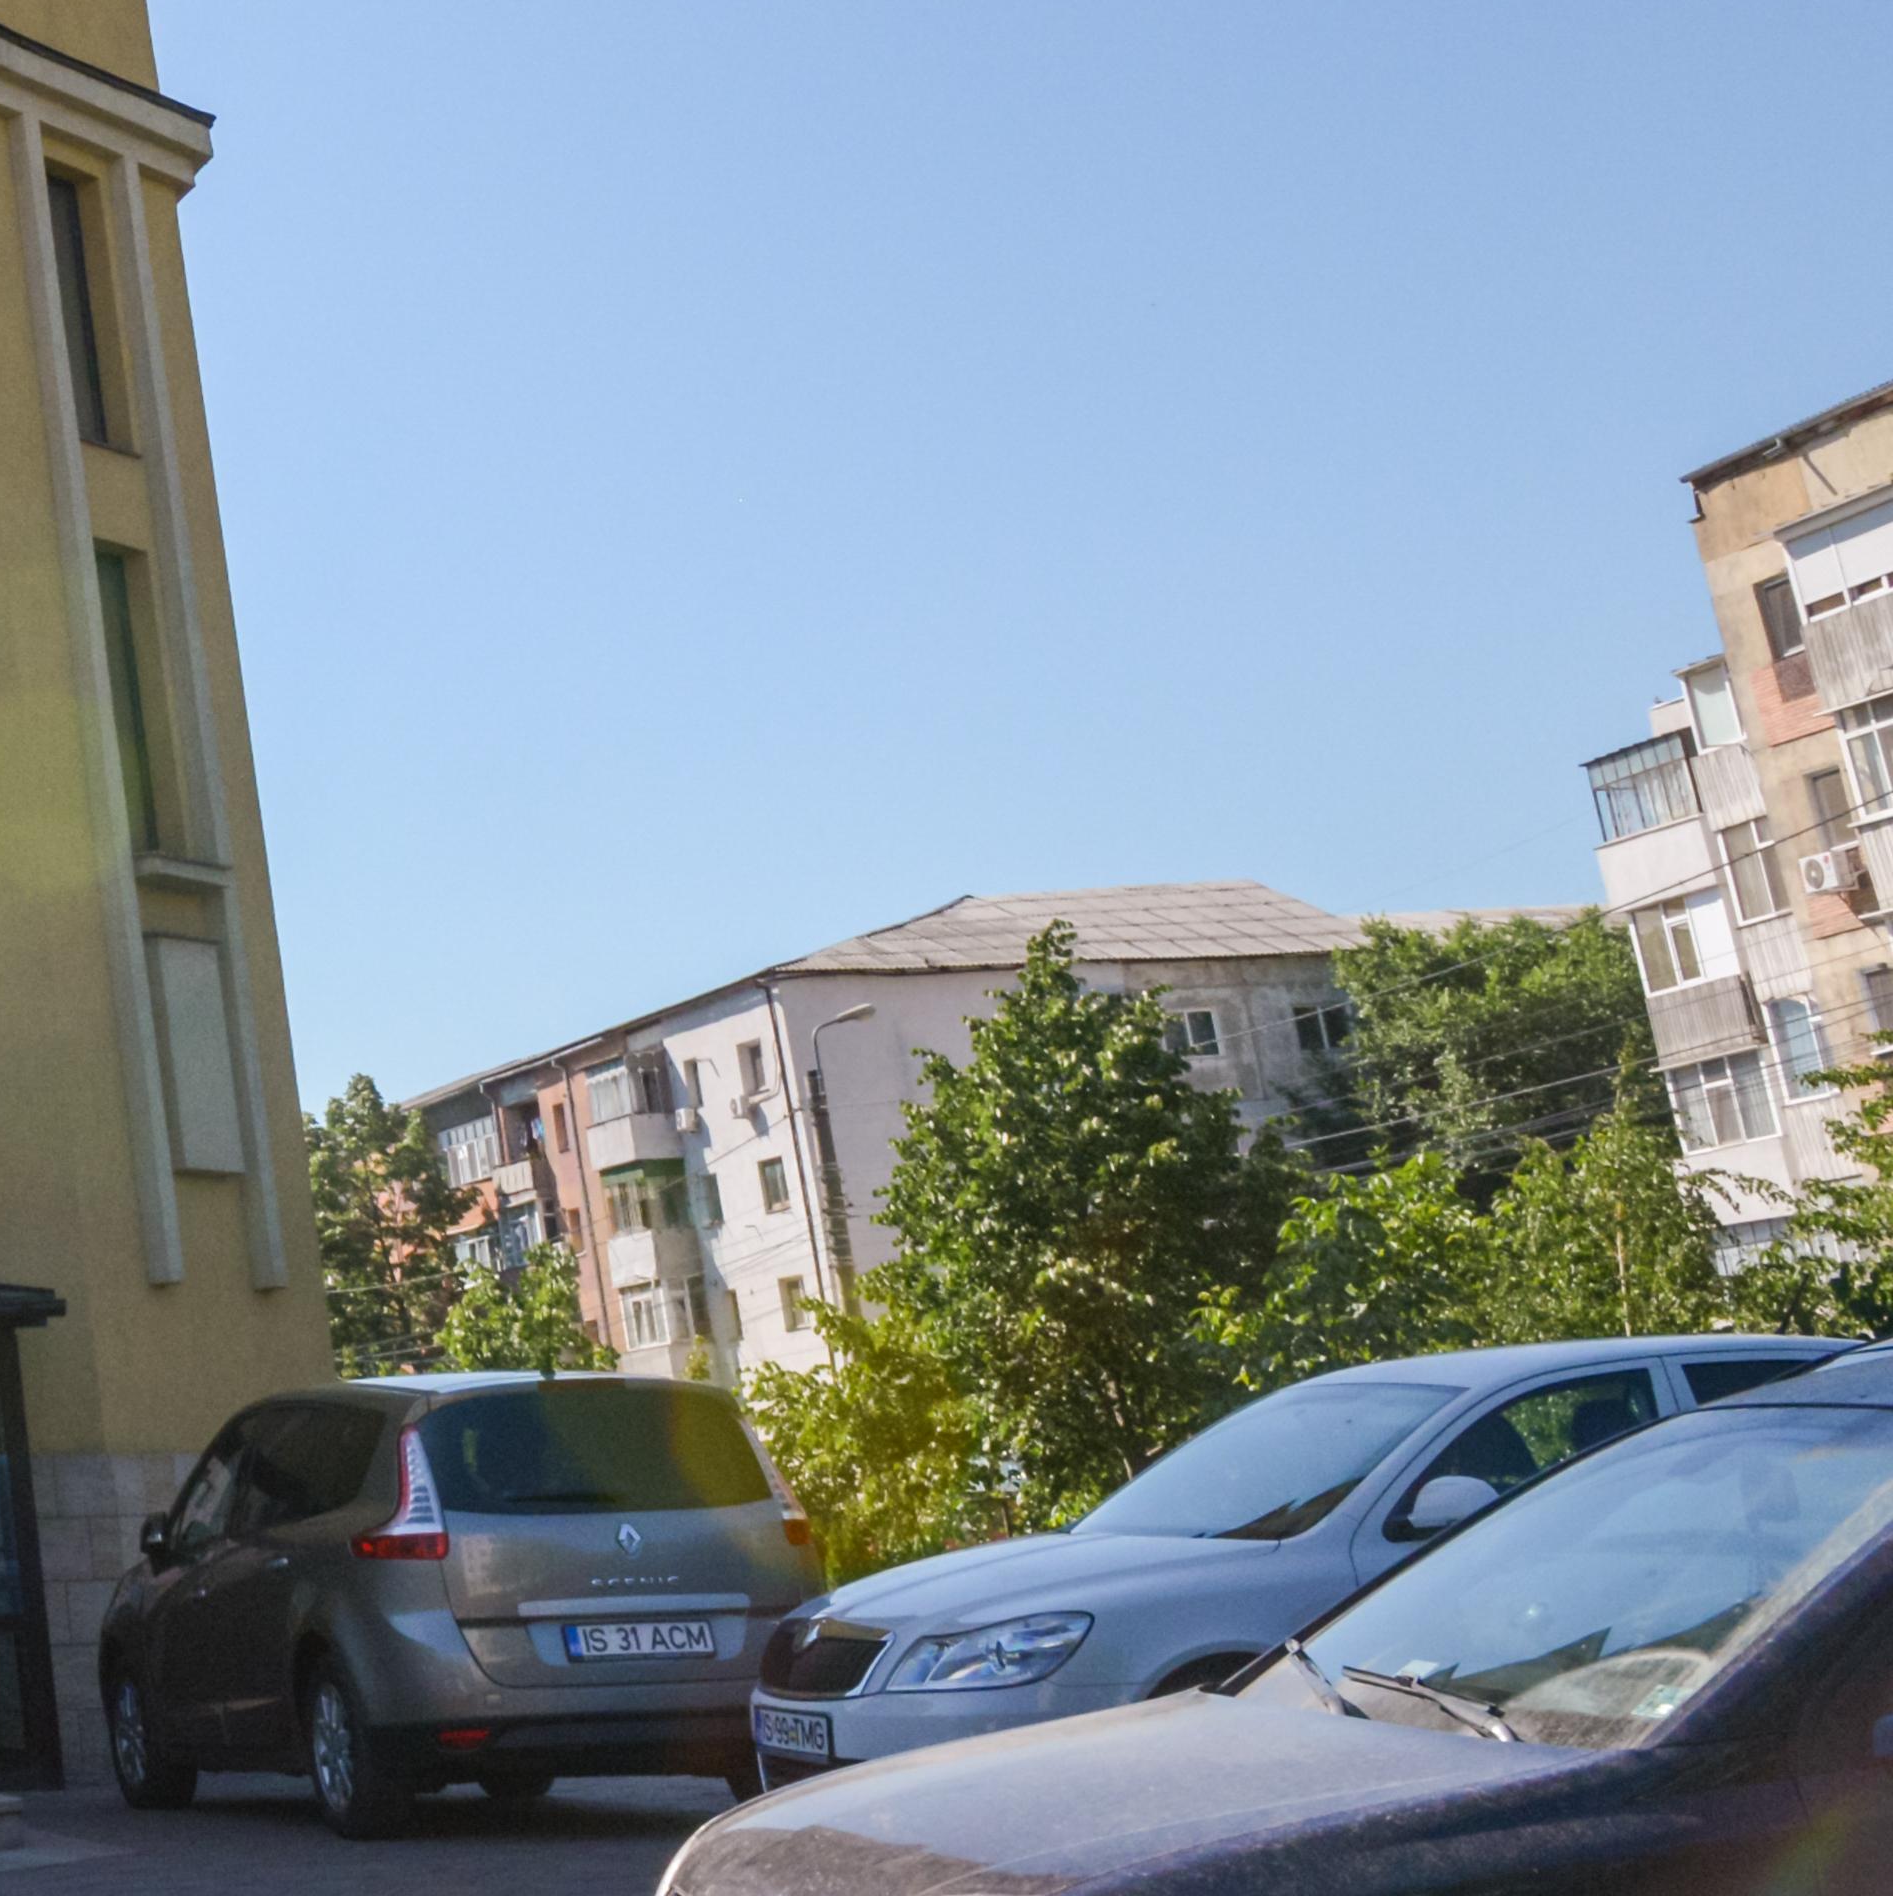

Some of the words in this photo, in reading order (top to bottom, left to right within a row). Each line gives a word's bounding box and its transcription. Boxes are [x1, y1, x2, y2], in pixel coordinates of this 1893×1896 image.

[582, 1627, 609, 1653] IS
[619, 1626, 641, 1651] 31
[651, 1625, 708, 1650] ACM
[792, 1717, 825, 1751] TMG
